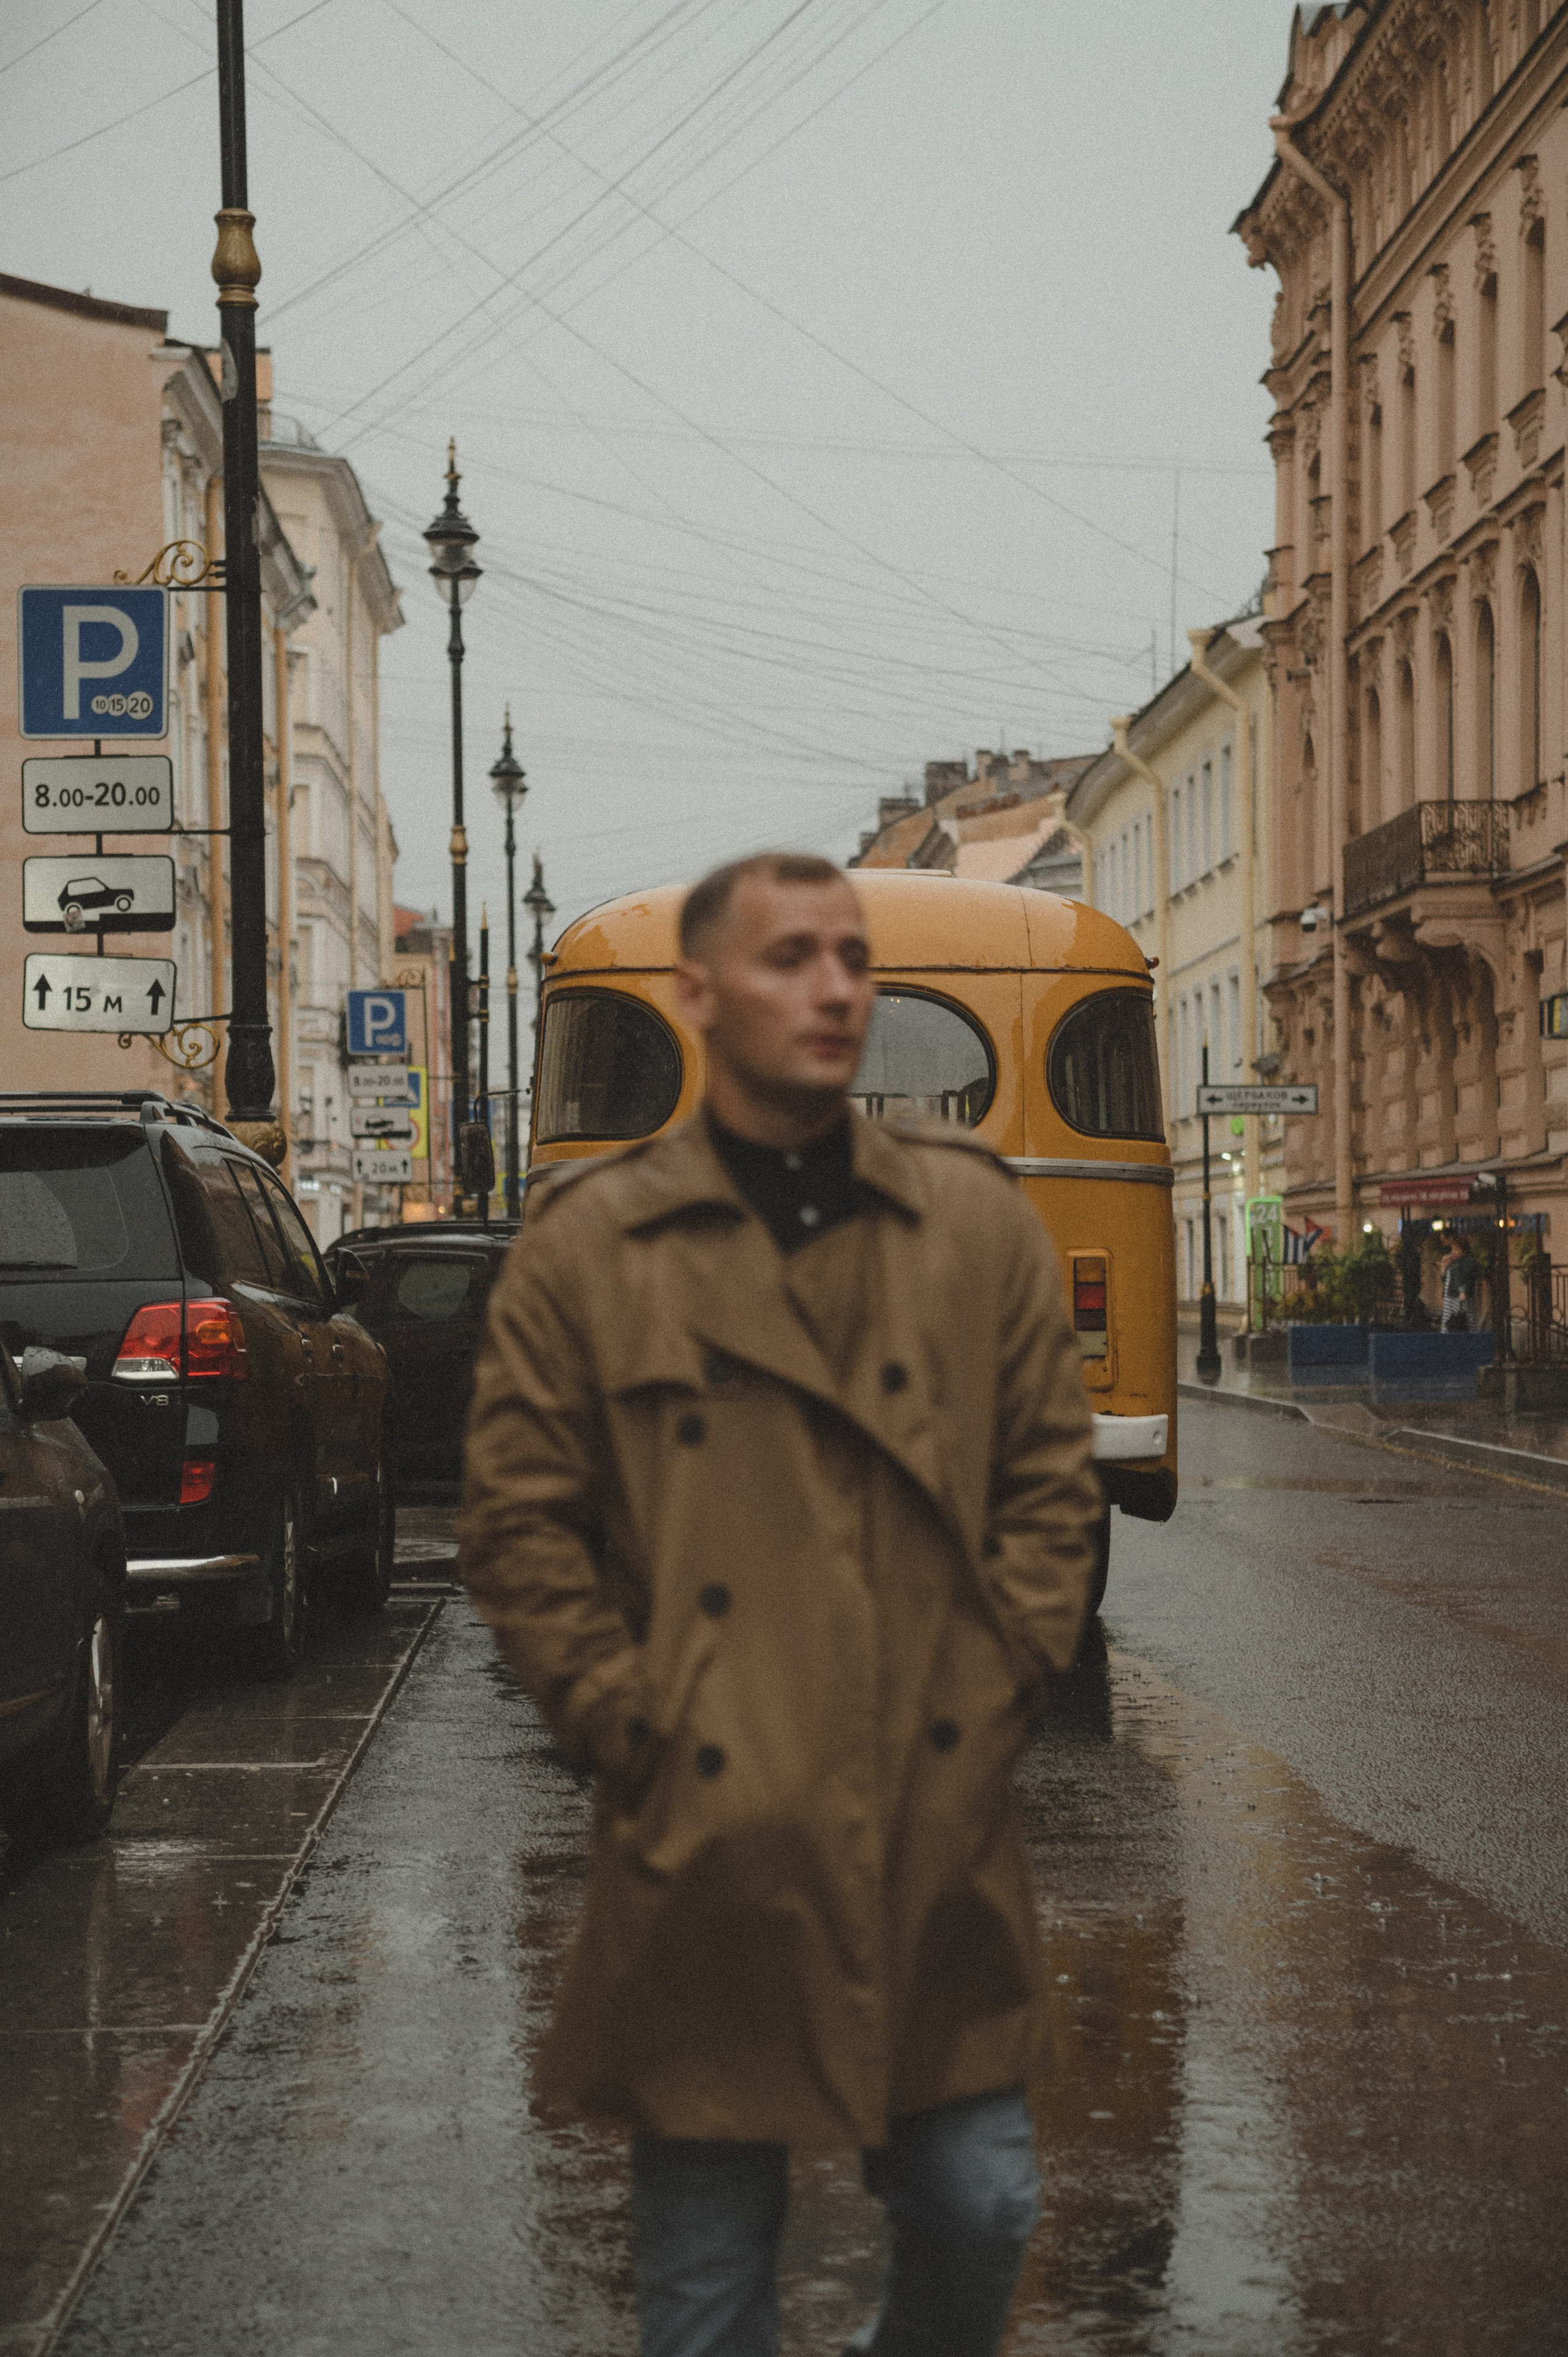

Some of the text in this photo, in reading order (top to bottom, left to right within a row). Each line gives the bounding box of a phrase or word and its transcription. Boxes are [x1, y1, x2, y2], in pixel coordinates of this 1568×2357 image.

[62, 605, 139, 719] P
[96, 698, 150, 713] 10 15 20
[35, 782, 160, 807] 8.00-20.00
[63, 987, 91, 1012] 15
[364, 997, 396, 1047] P
[1256, 1204, 1278, 1223] 24
[140, 1395, 169, 1406] V8
